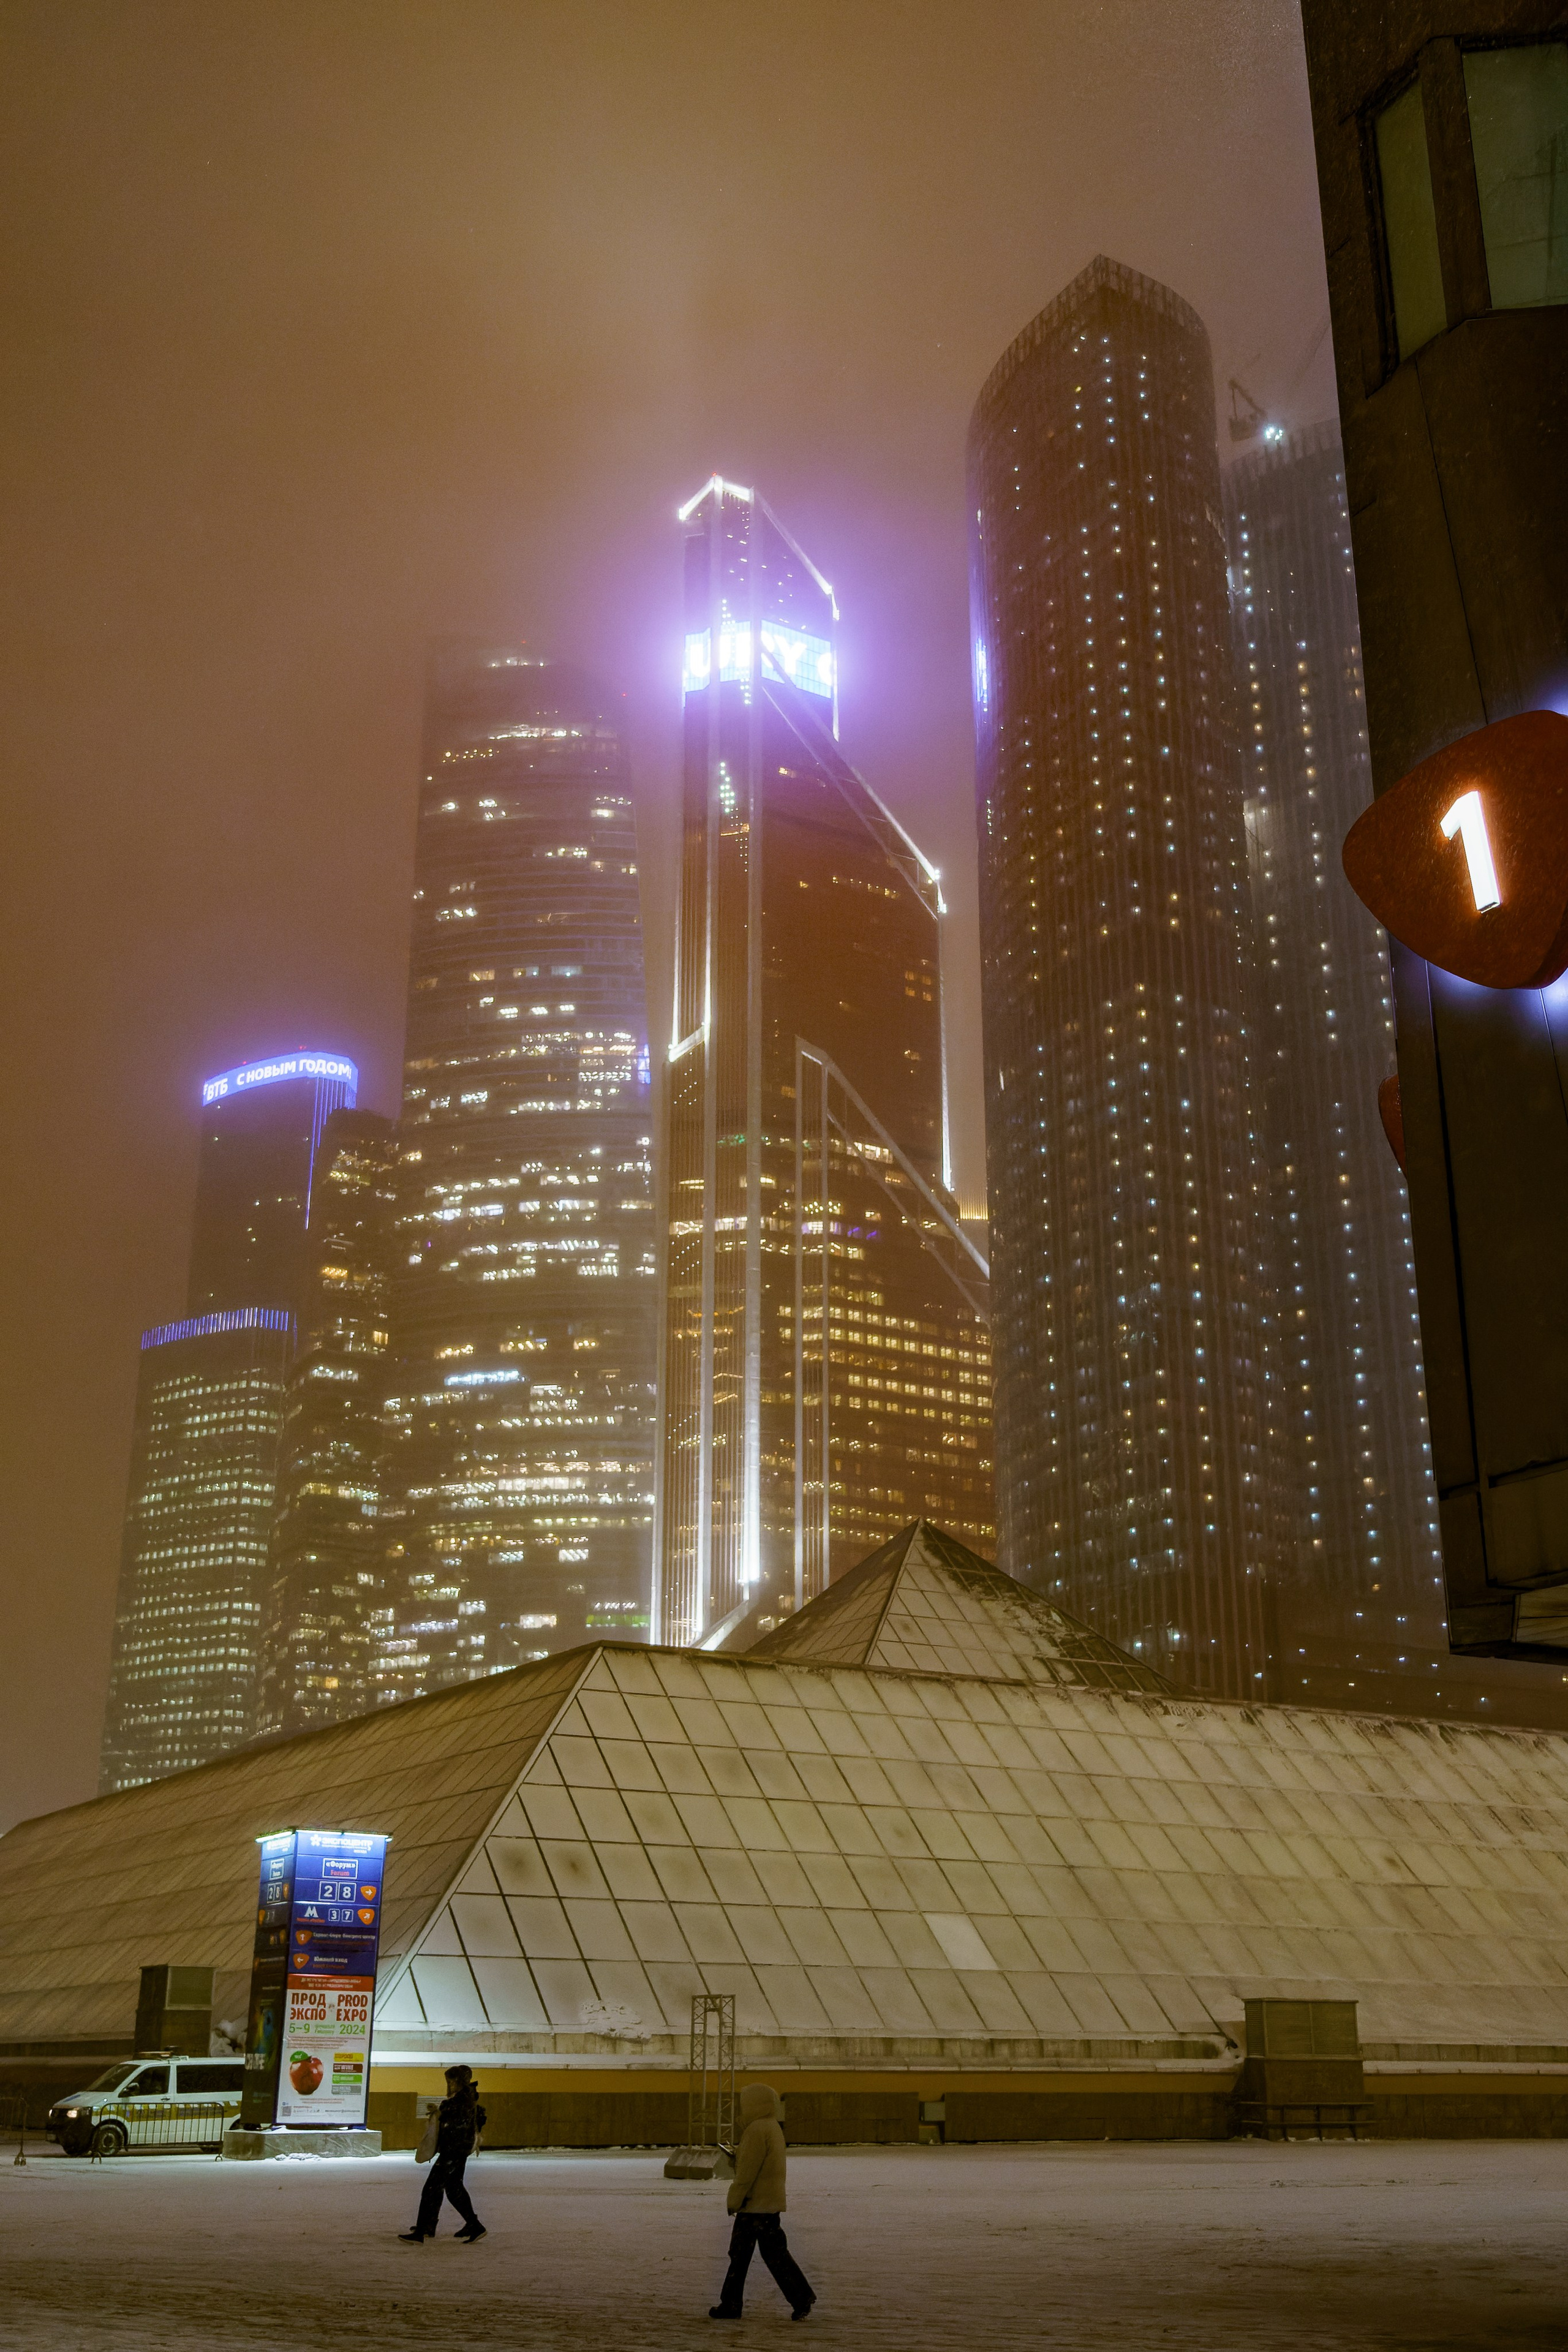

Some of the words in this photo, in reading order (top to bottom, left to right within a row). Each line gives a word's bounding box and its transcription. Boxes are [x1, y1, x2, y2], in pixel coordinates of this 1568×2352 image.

[1440, 790, 1501, 914] 1
[206, 1077, 228, 1101] ВТБ
[236, 1073, 245, 1086] С
[246, 1061, 296, 1084] НОВЫМ
[323, 1885, 333, 1898] 2
[342, 1886, 352, 1899] 8
[331, 1910, 337, 1920] 3
[344, 1910, 351, 1920] 7
[291, 1992, 326, 2008] ПРОД
[337, 1994, 369, 2008] PROD
[290, 2007, 327, 2021] ЭКСПО
[336, 2008, 368, 2022] EXPO
[339, 2024, 366, 2035] 2024
